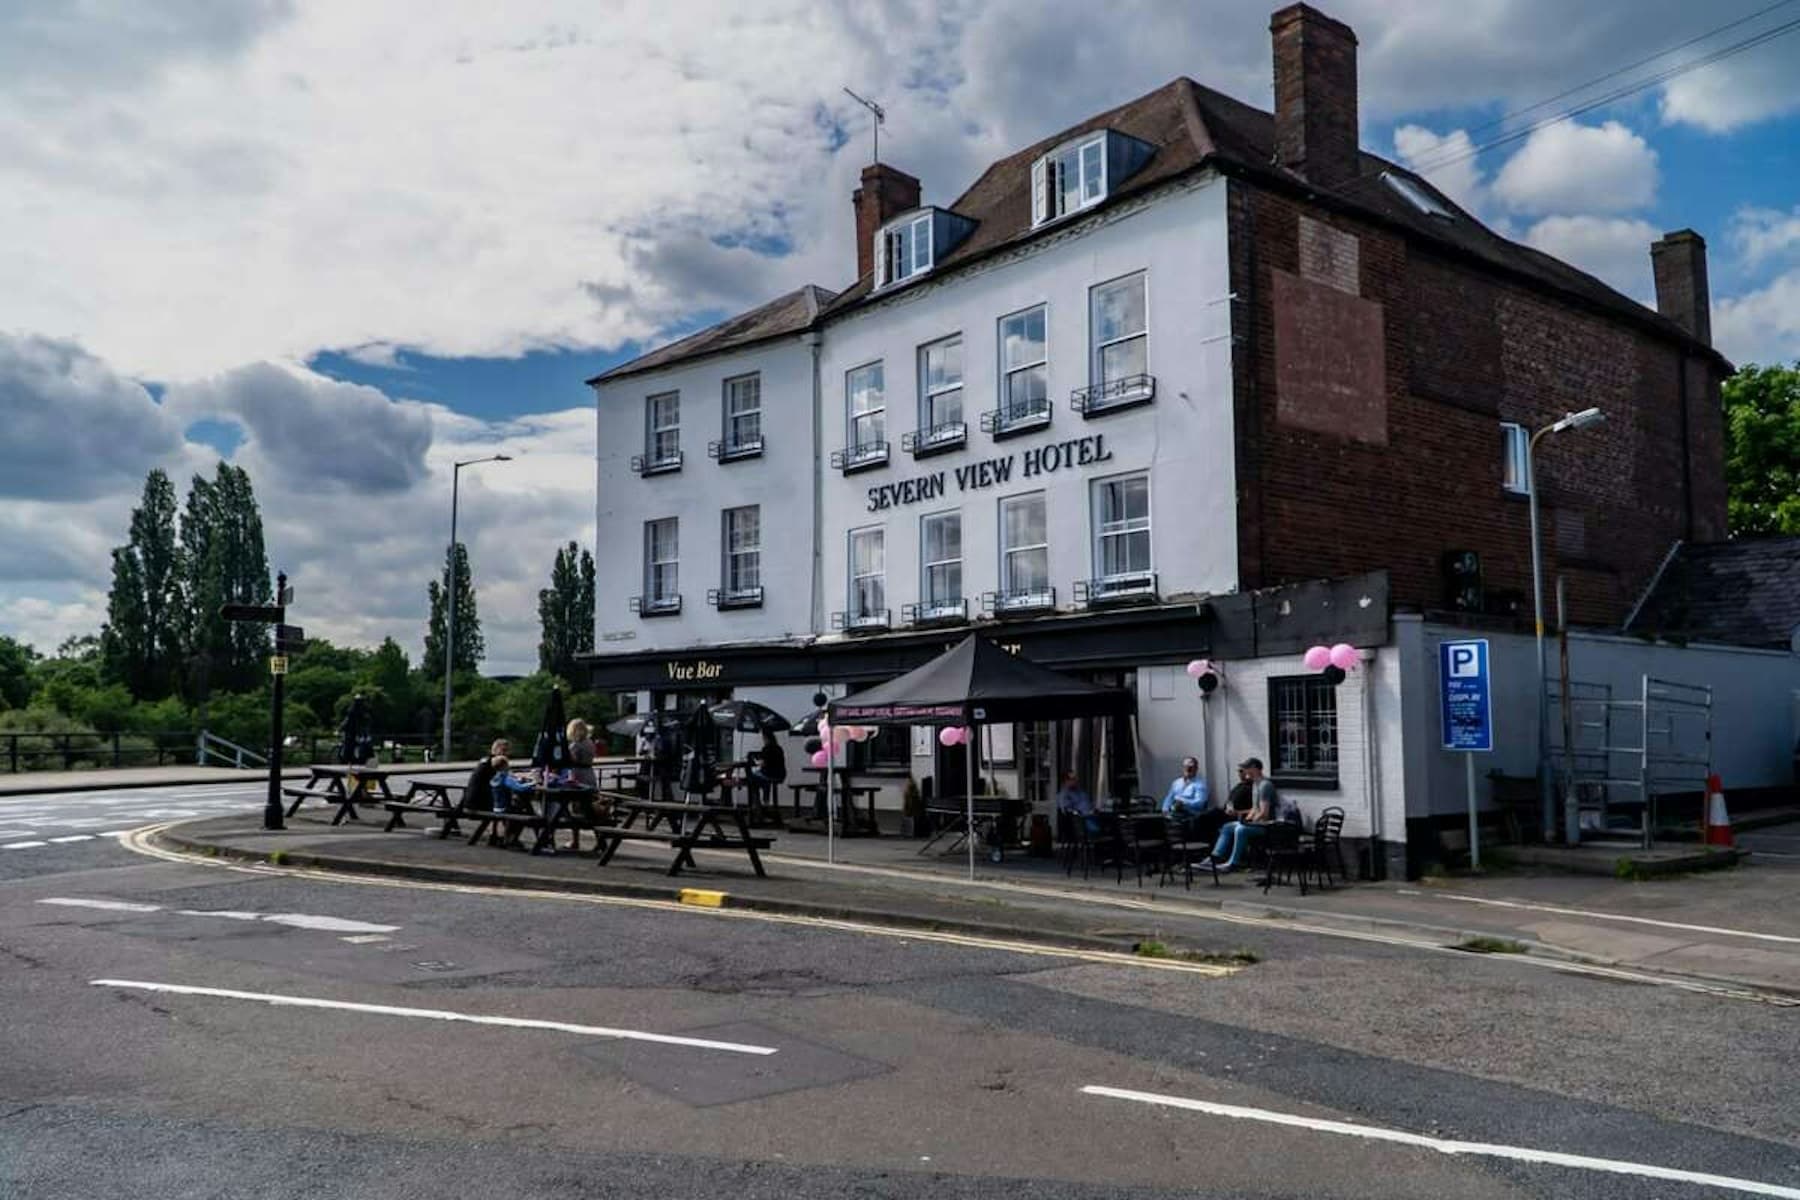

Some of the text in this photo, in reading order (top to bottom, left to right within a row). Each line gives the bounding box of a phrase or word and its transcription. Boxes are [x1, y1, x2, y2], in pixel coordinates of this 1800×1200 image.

[867, 433, 1113, 512] SEVERN VIEW HOTEL
[668, 660, 723, 680] Vue Bar
[1453, 649, 1473, 674] P
